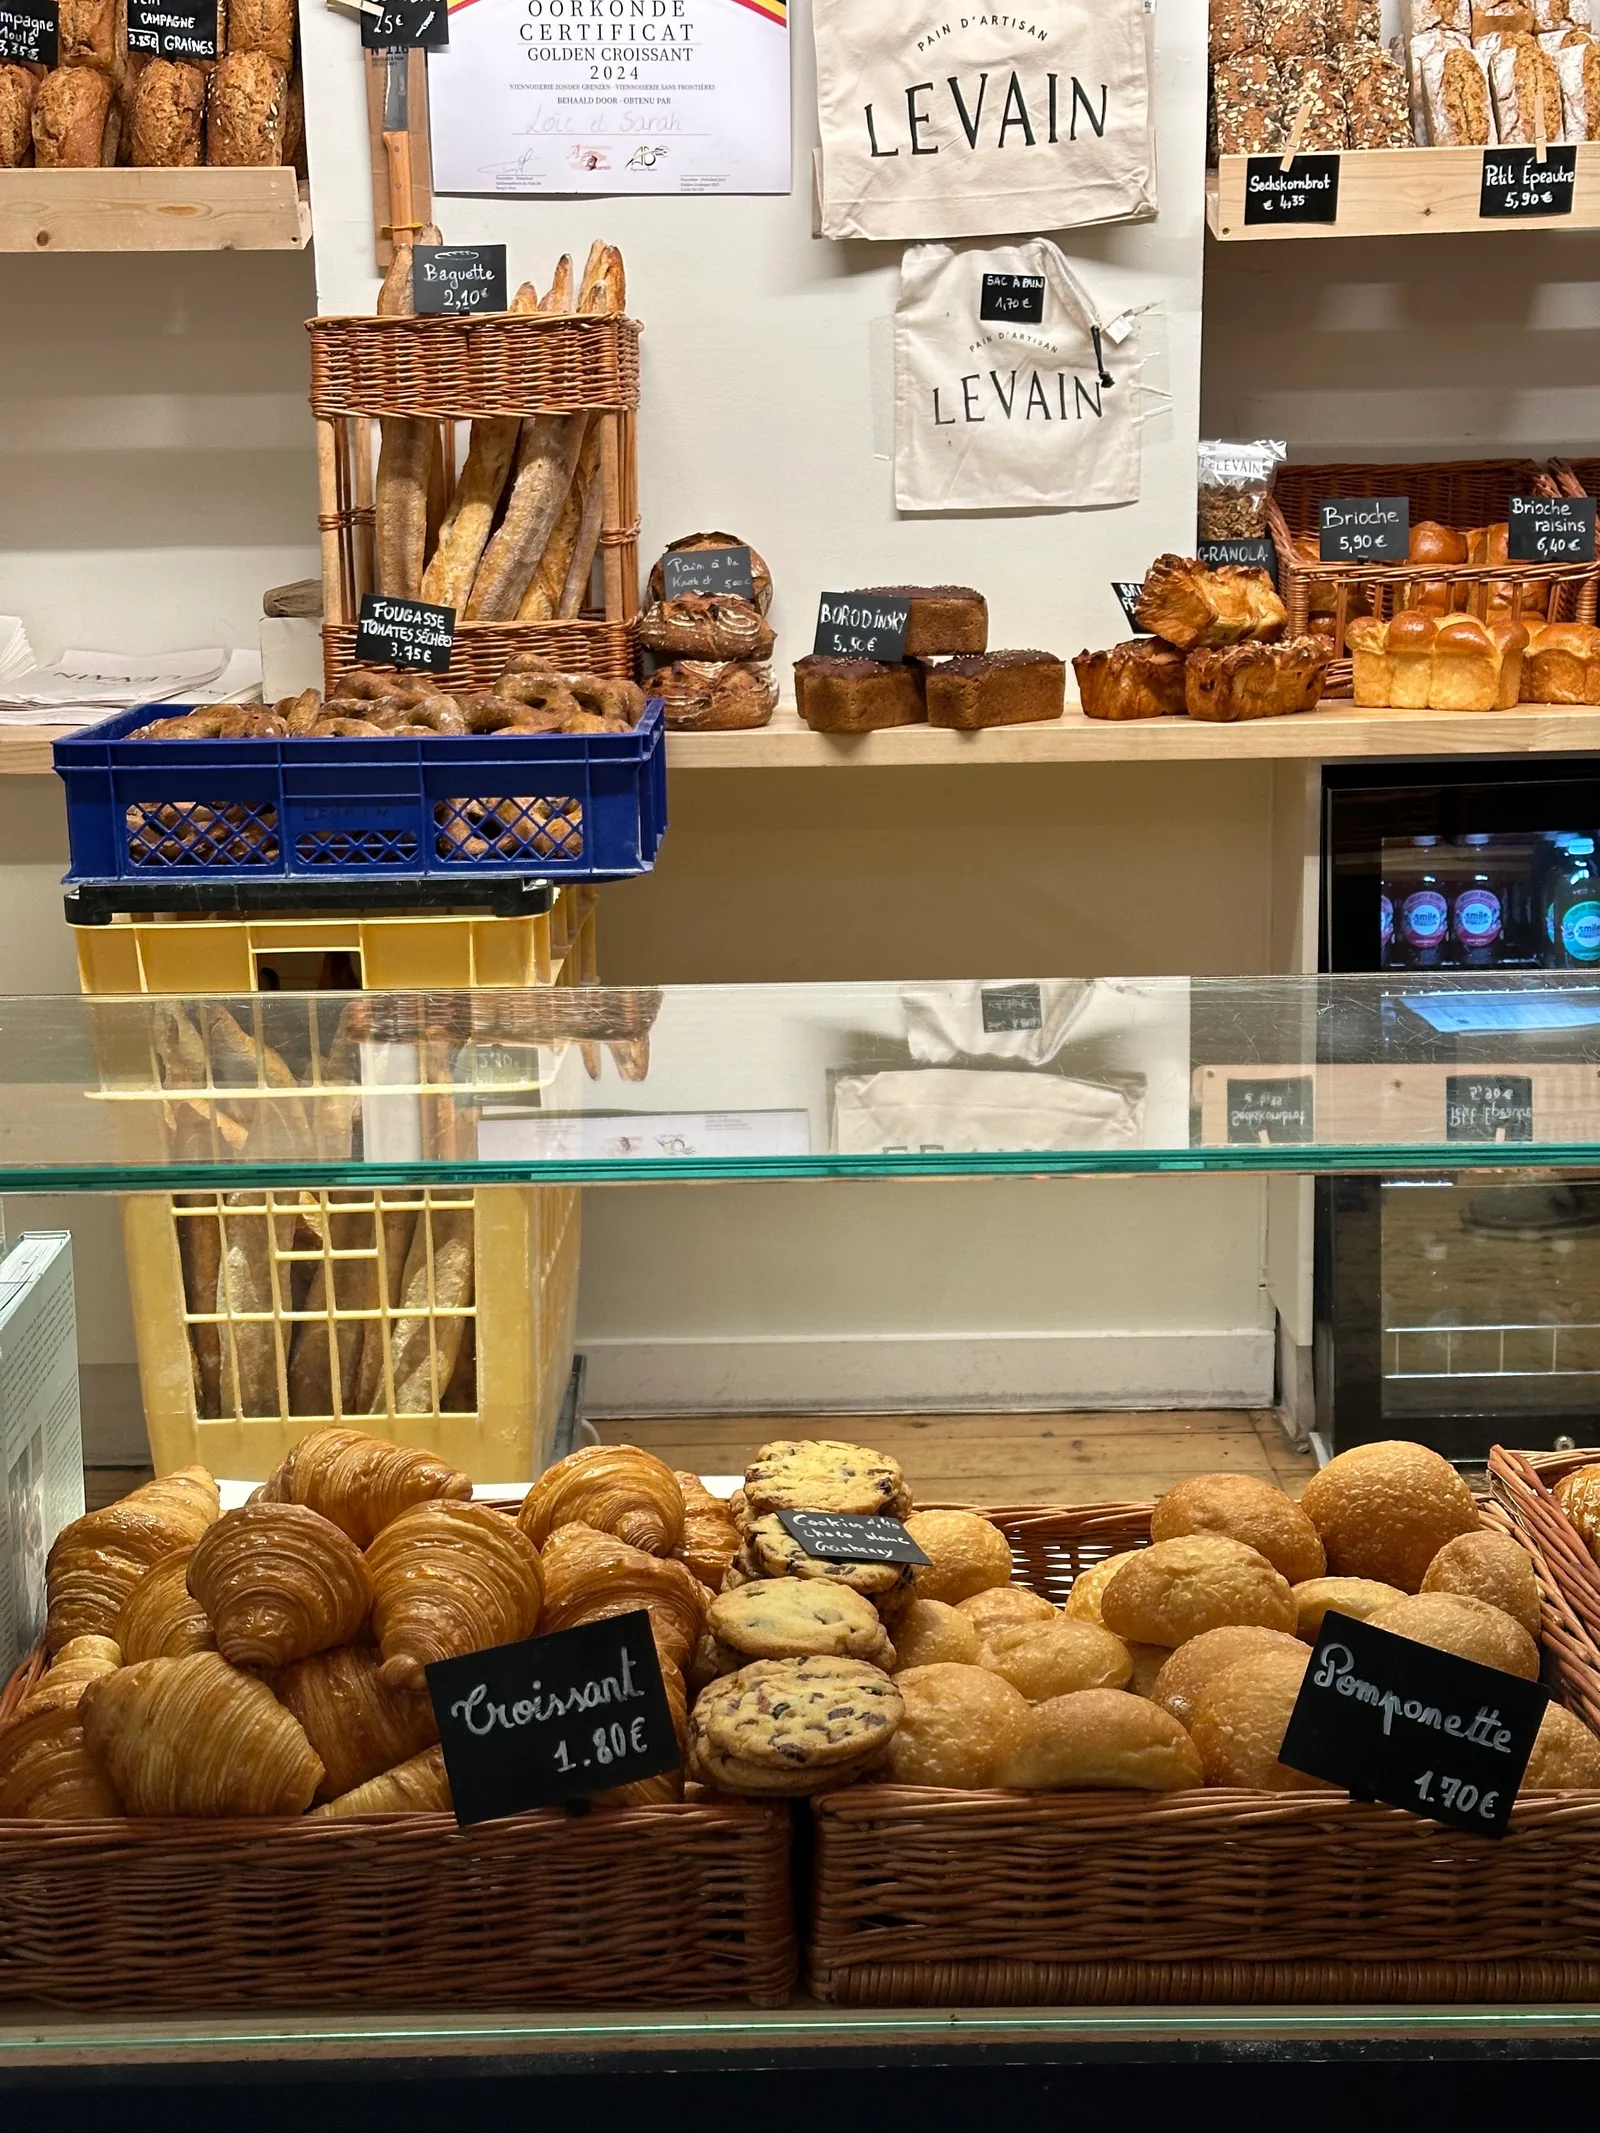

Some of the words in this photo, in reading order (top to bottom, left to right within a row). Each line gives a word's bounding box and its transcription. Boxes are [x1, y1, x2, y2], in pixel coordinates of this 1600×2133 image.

[528, 0, 685, 17] OORKONDE
[0, 11, 54, 38] mpagne
[140, 12, 196, 29] CAMPAGNE
[519, 23, 694, 41] CERTIFICAT
[917, 23, 951, 52] PAIN
[960, 15, 1049, 42] D'ARTISAN
[527, 48, 596, 62] GOLDEN
[601, 48, 694, 62] CROISSANT
[589, 66, 640, 80] 2024
[557, 96, 595, 105] BEHAALD
[595, 96, 618, 105] DOOR
[623, 96, 655, 105] OBTENU
[656, 96, 672, 105] PAR
[619, 110, 684, 133] Sarah
[864, 71, 1108, 158] LEVAIN
[1248, 173, 1332, 193] Sechskornbrot
[1485, 164, 1516, 187] Petit
[1522, 156, 1576, 191] Épeautre
[1280, 194, 1306, 210] 4,35
[1504, 190, 1553, 210] 5,90€
[423, 262, 496, 290] Baguette
[986, 275, 1008, 287] SAC
[1022, 277, 1044, 289] PAIN
[968, 334, 994, 353] PAIN
[998, 331, 1059, 354] D'ARTISAN
[932, 369, 1103, 426] LEVAIN
[1322, 502, 1400, 530] Brioche
[1512, 498, 1572, 517] Brioche
[1534, 516, 1587, 533] raisins
[1197, 545, 1269, 563] GRANOLA
[667, 557, 705, 574] Pain
[372, 601, 446, 630] FOUGASSE
[360, 618, 415, 642] TOMATES
[390, 641, 432, 663] 3.75€
[792, 1514, 865, 1530] Cookies
[450, 1645, 646, 1736] Croissant
[1313, 1642, 1512, 1754] Pomponette
[553, 1716, 649, 1773] 1.80€
[1413, 1770, 1500, 1819] 1.70€
